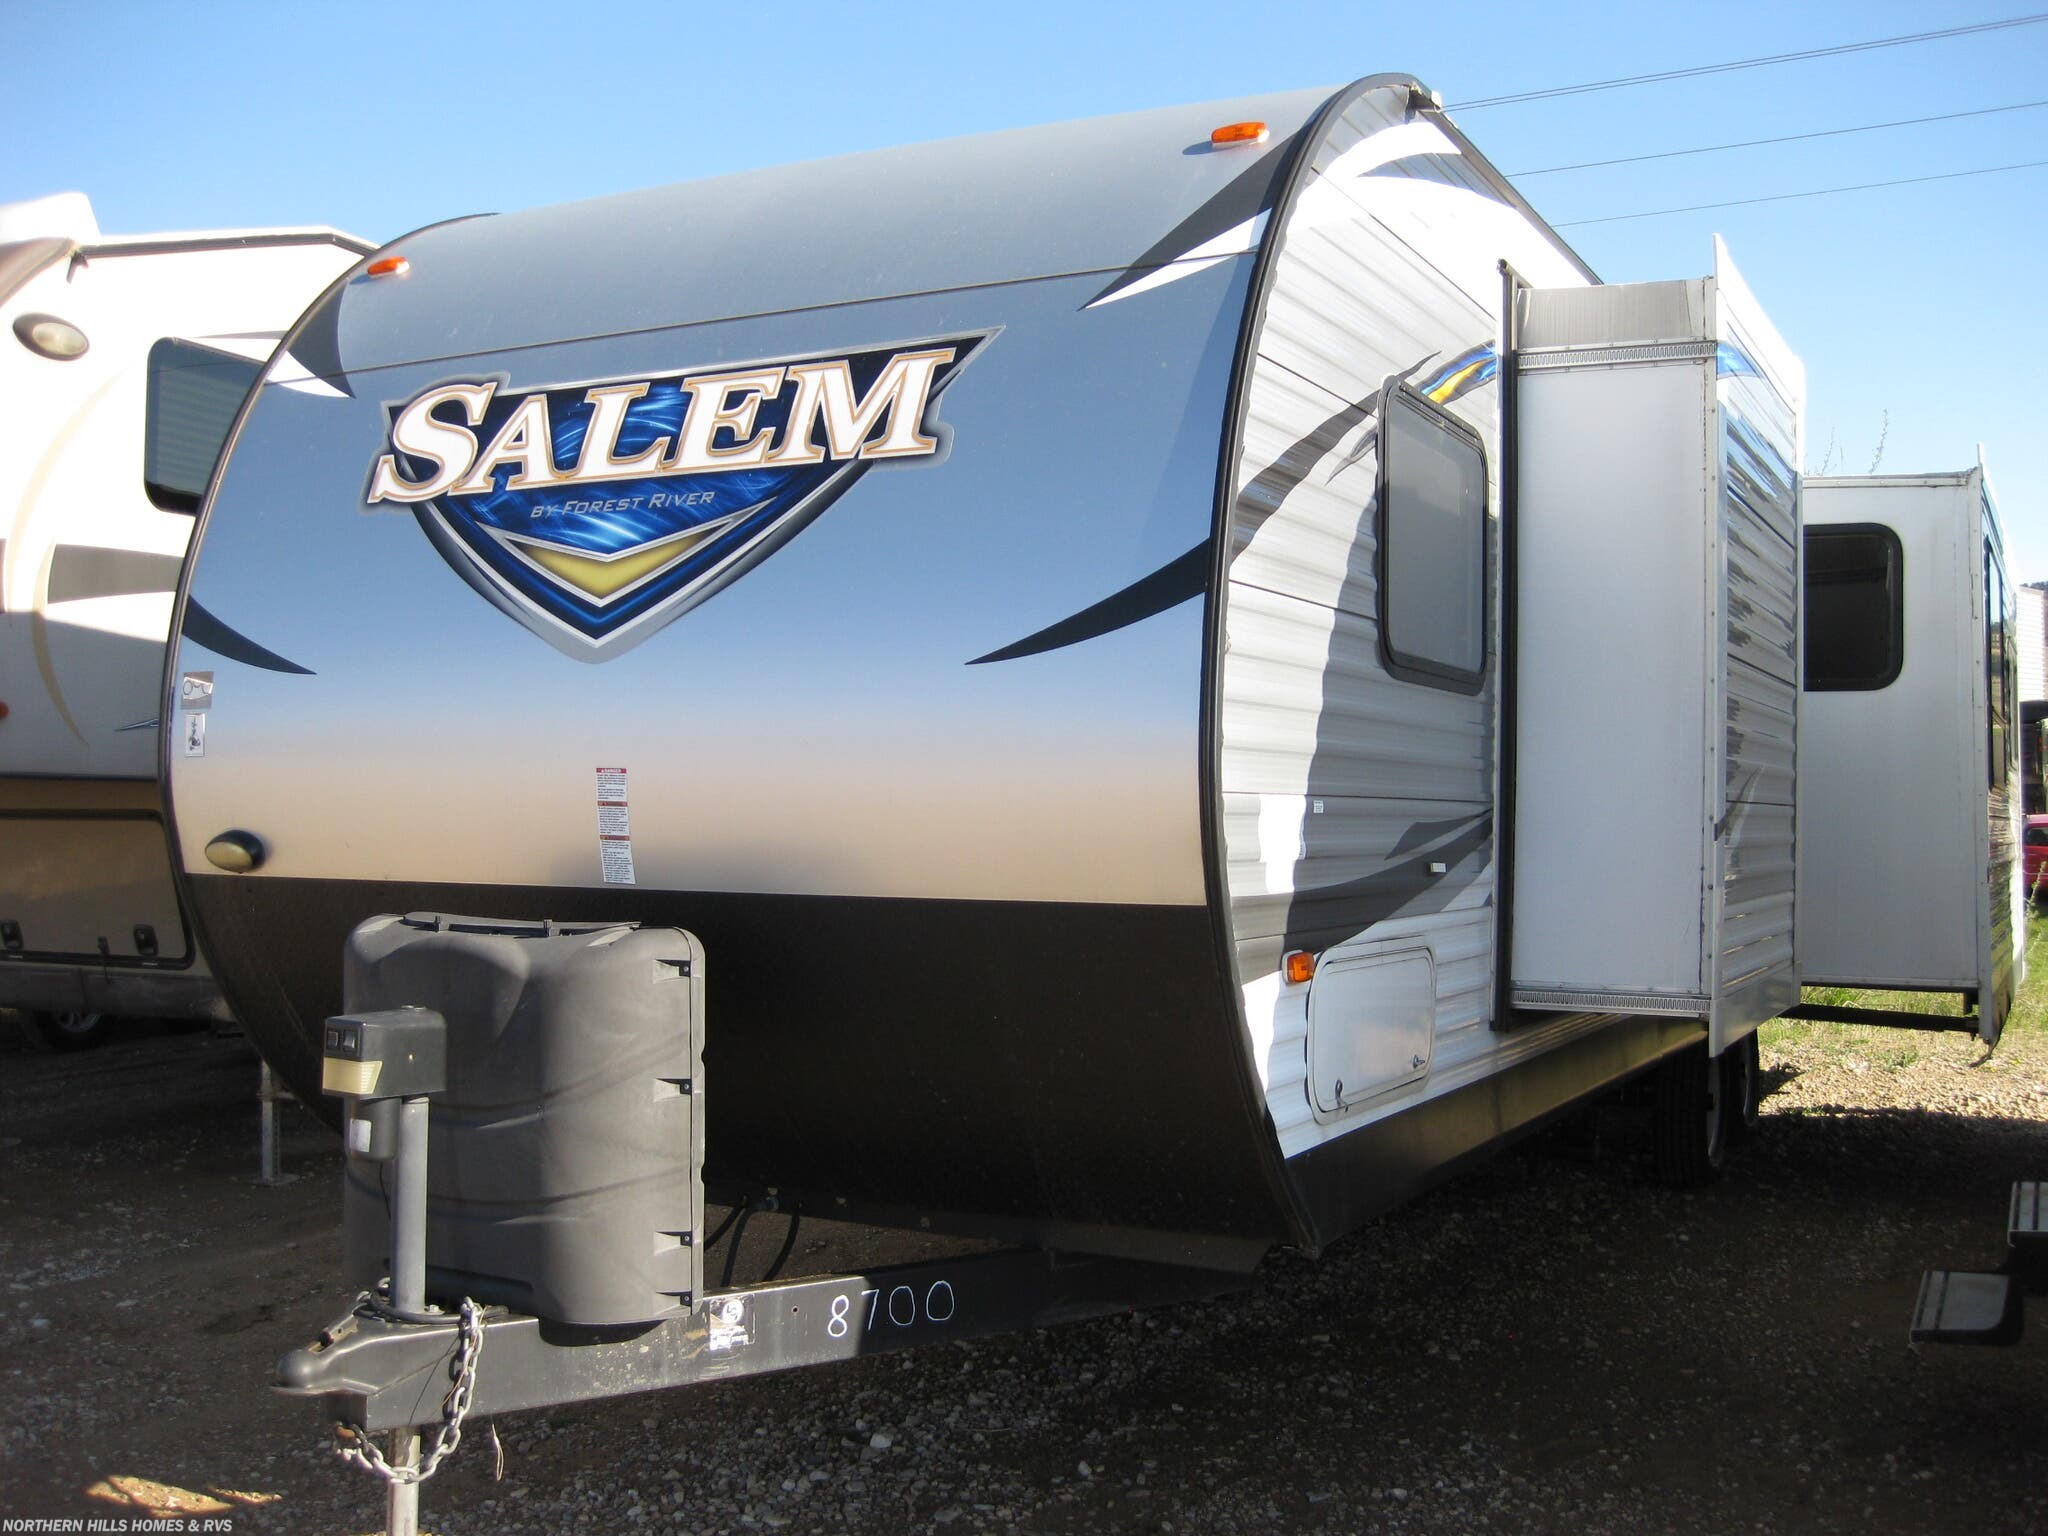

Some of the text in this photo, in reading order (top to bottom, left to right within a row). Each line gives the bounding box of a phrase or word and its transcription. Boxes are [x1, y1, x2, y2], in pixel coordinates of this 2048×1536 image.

[367, 348, 955, 503] SALEM
[530, 491, 715, 519] BY FOREST RIVER
[828, 1280, 954, 1337] 8700
